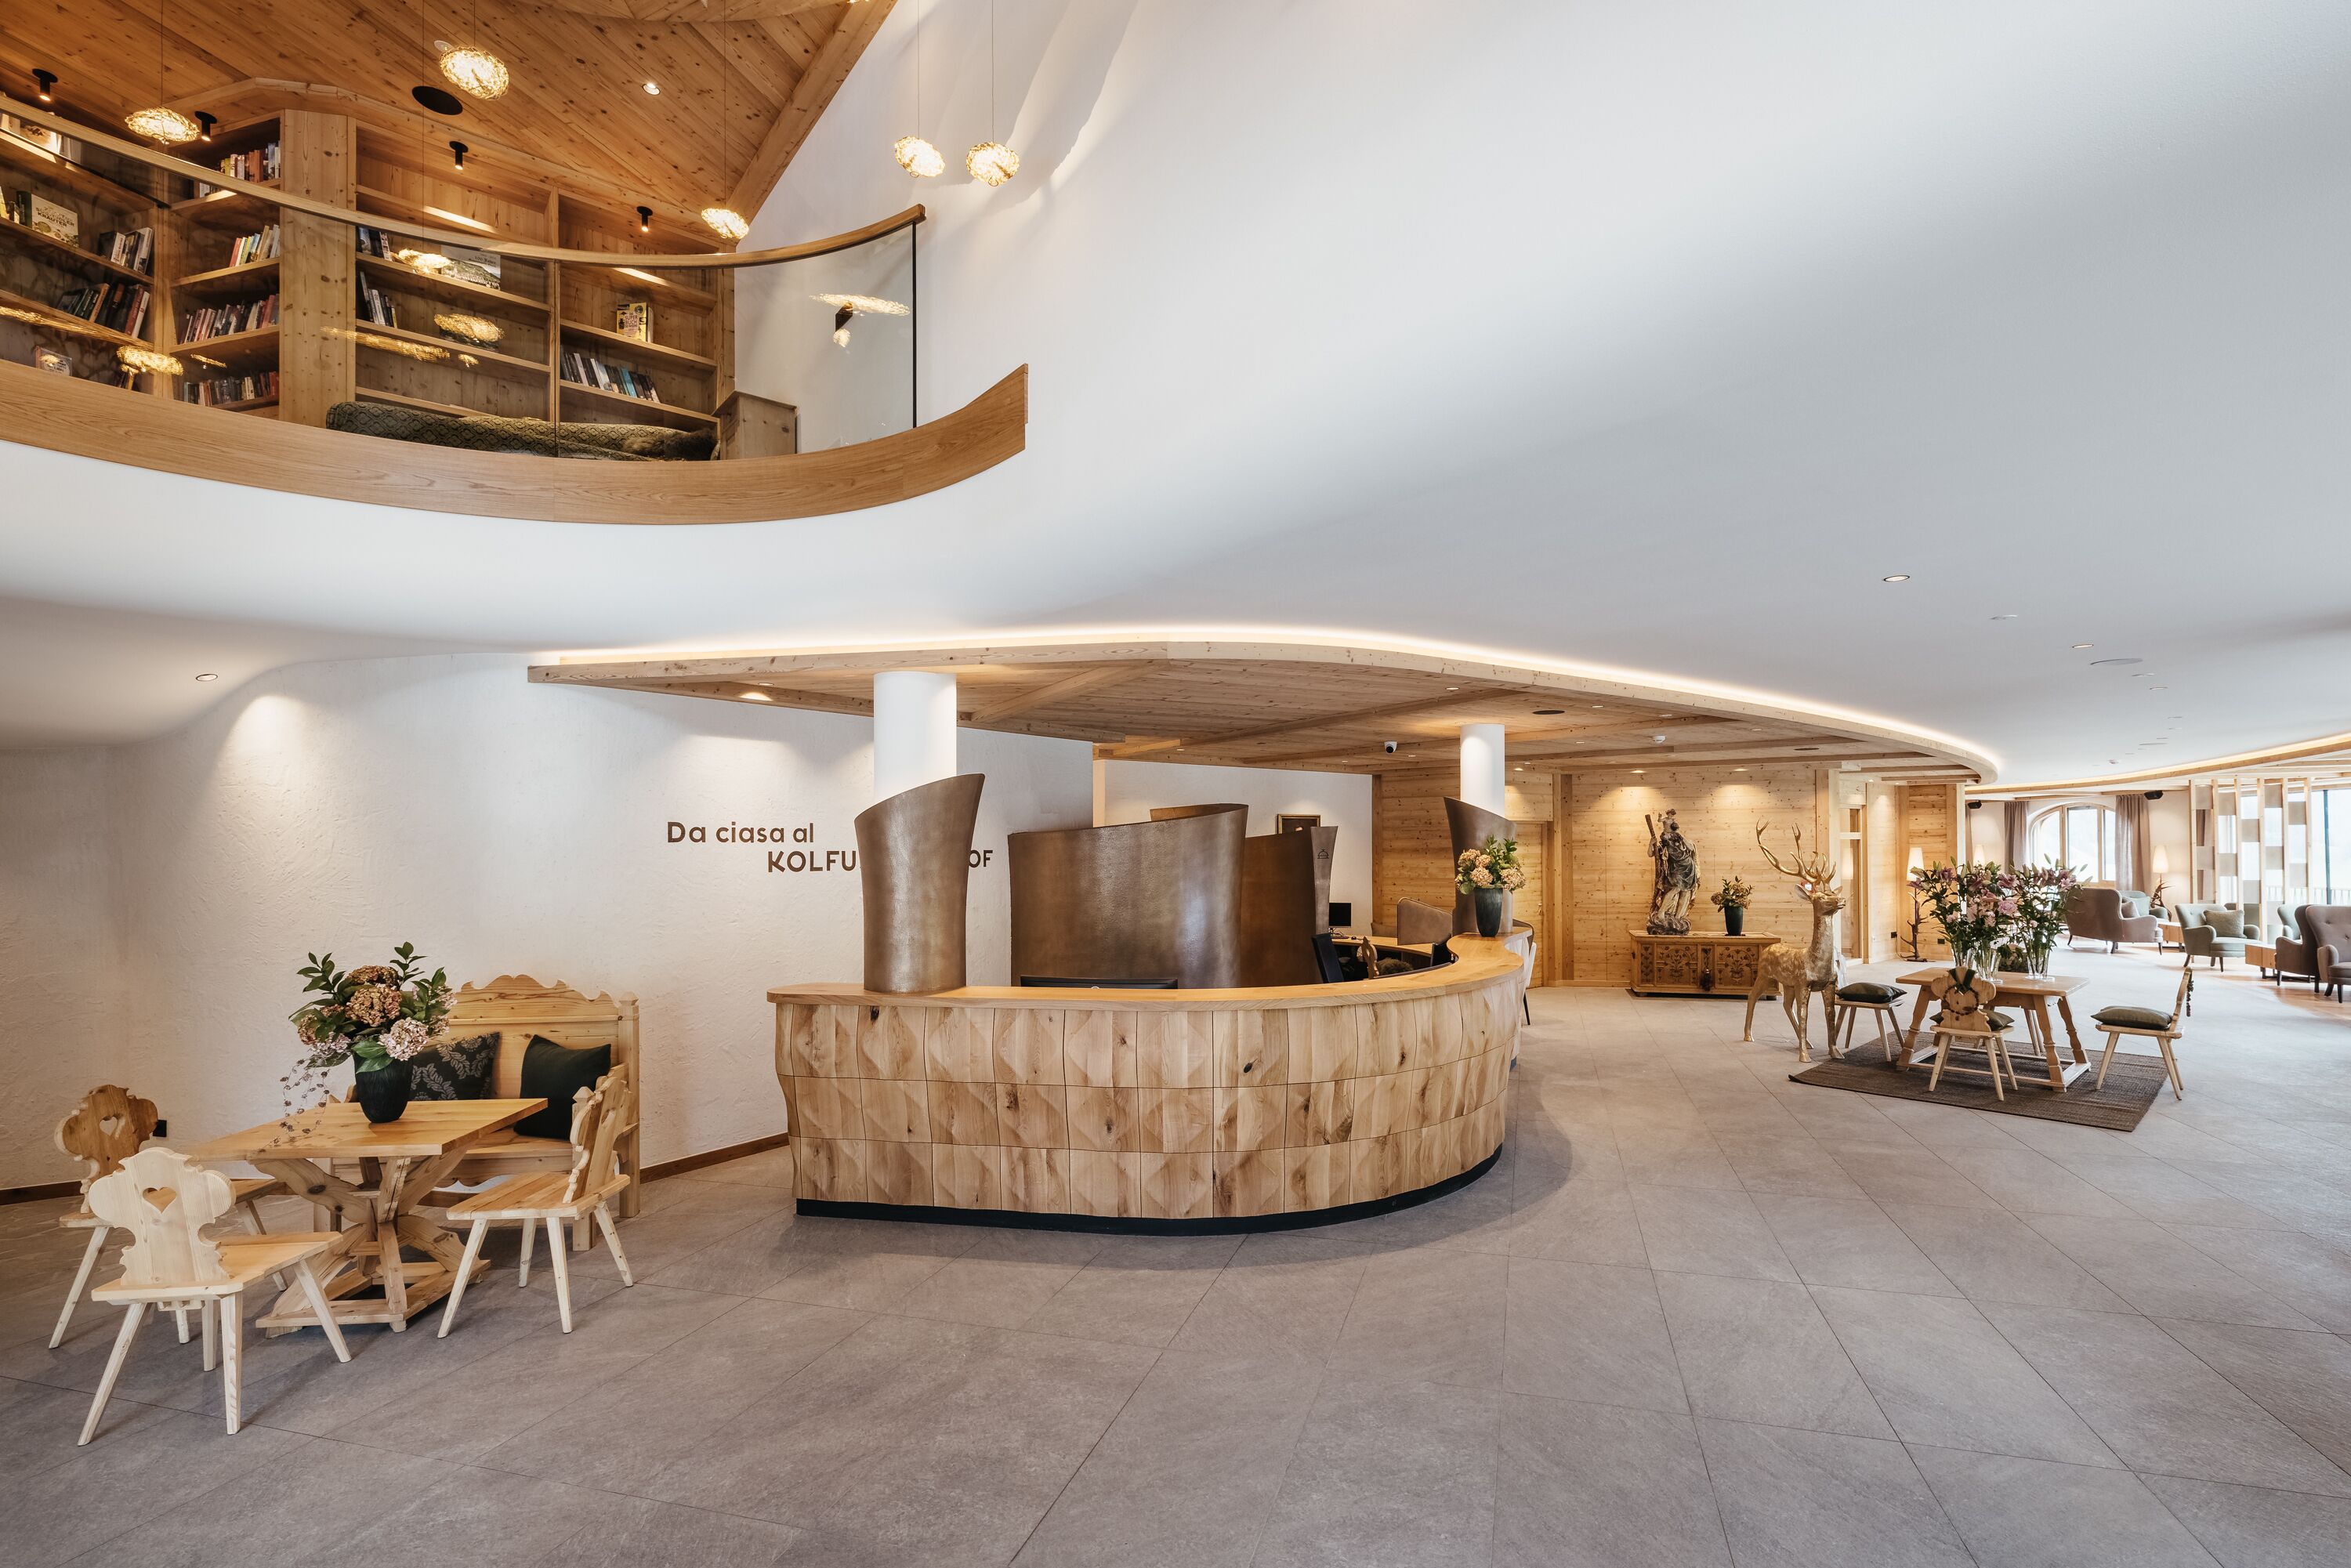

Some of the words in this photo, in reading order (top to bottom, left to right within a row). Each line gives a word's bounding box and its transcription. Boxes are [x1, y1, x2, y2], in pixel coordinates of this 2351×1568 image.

[667, 821, 706, 843] Da
[715, 821, 784, 843] ciasa
[792, 822, 814, 843] al
